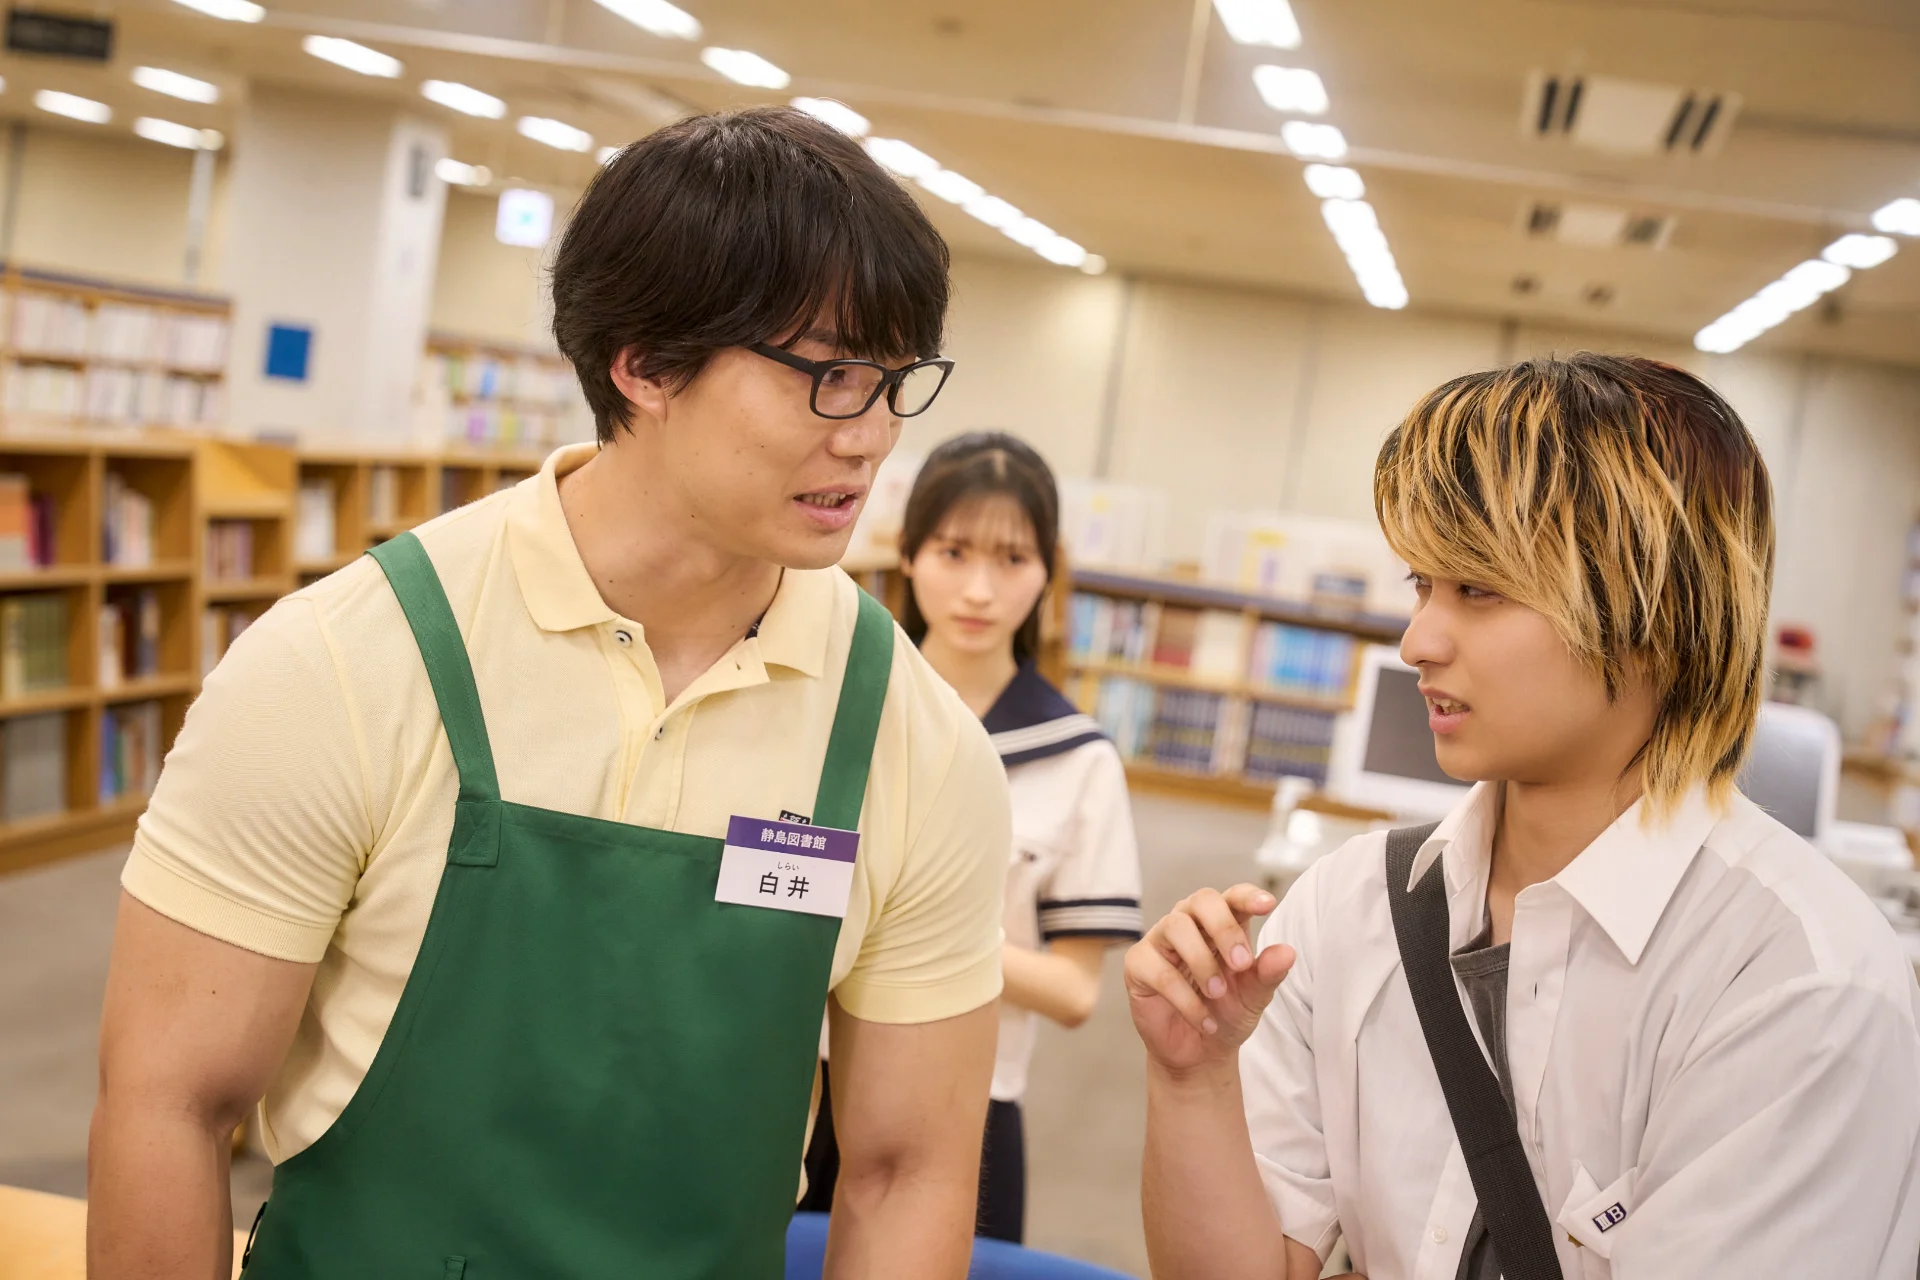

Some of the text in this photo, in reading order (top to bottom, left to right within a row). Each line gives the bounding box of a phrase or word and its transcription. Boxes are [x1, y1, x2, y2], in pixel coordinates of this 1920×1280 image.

[761, 828, 827, 850] 静島図書館
[777, 861, 800, 871] しらい
[759, 871, 810, 900] 白井
